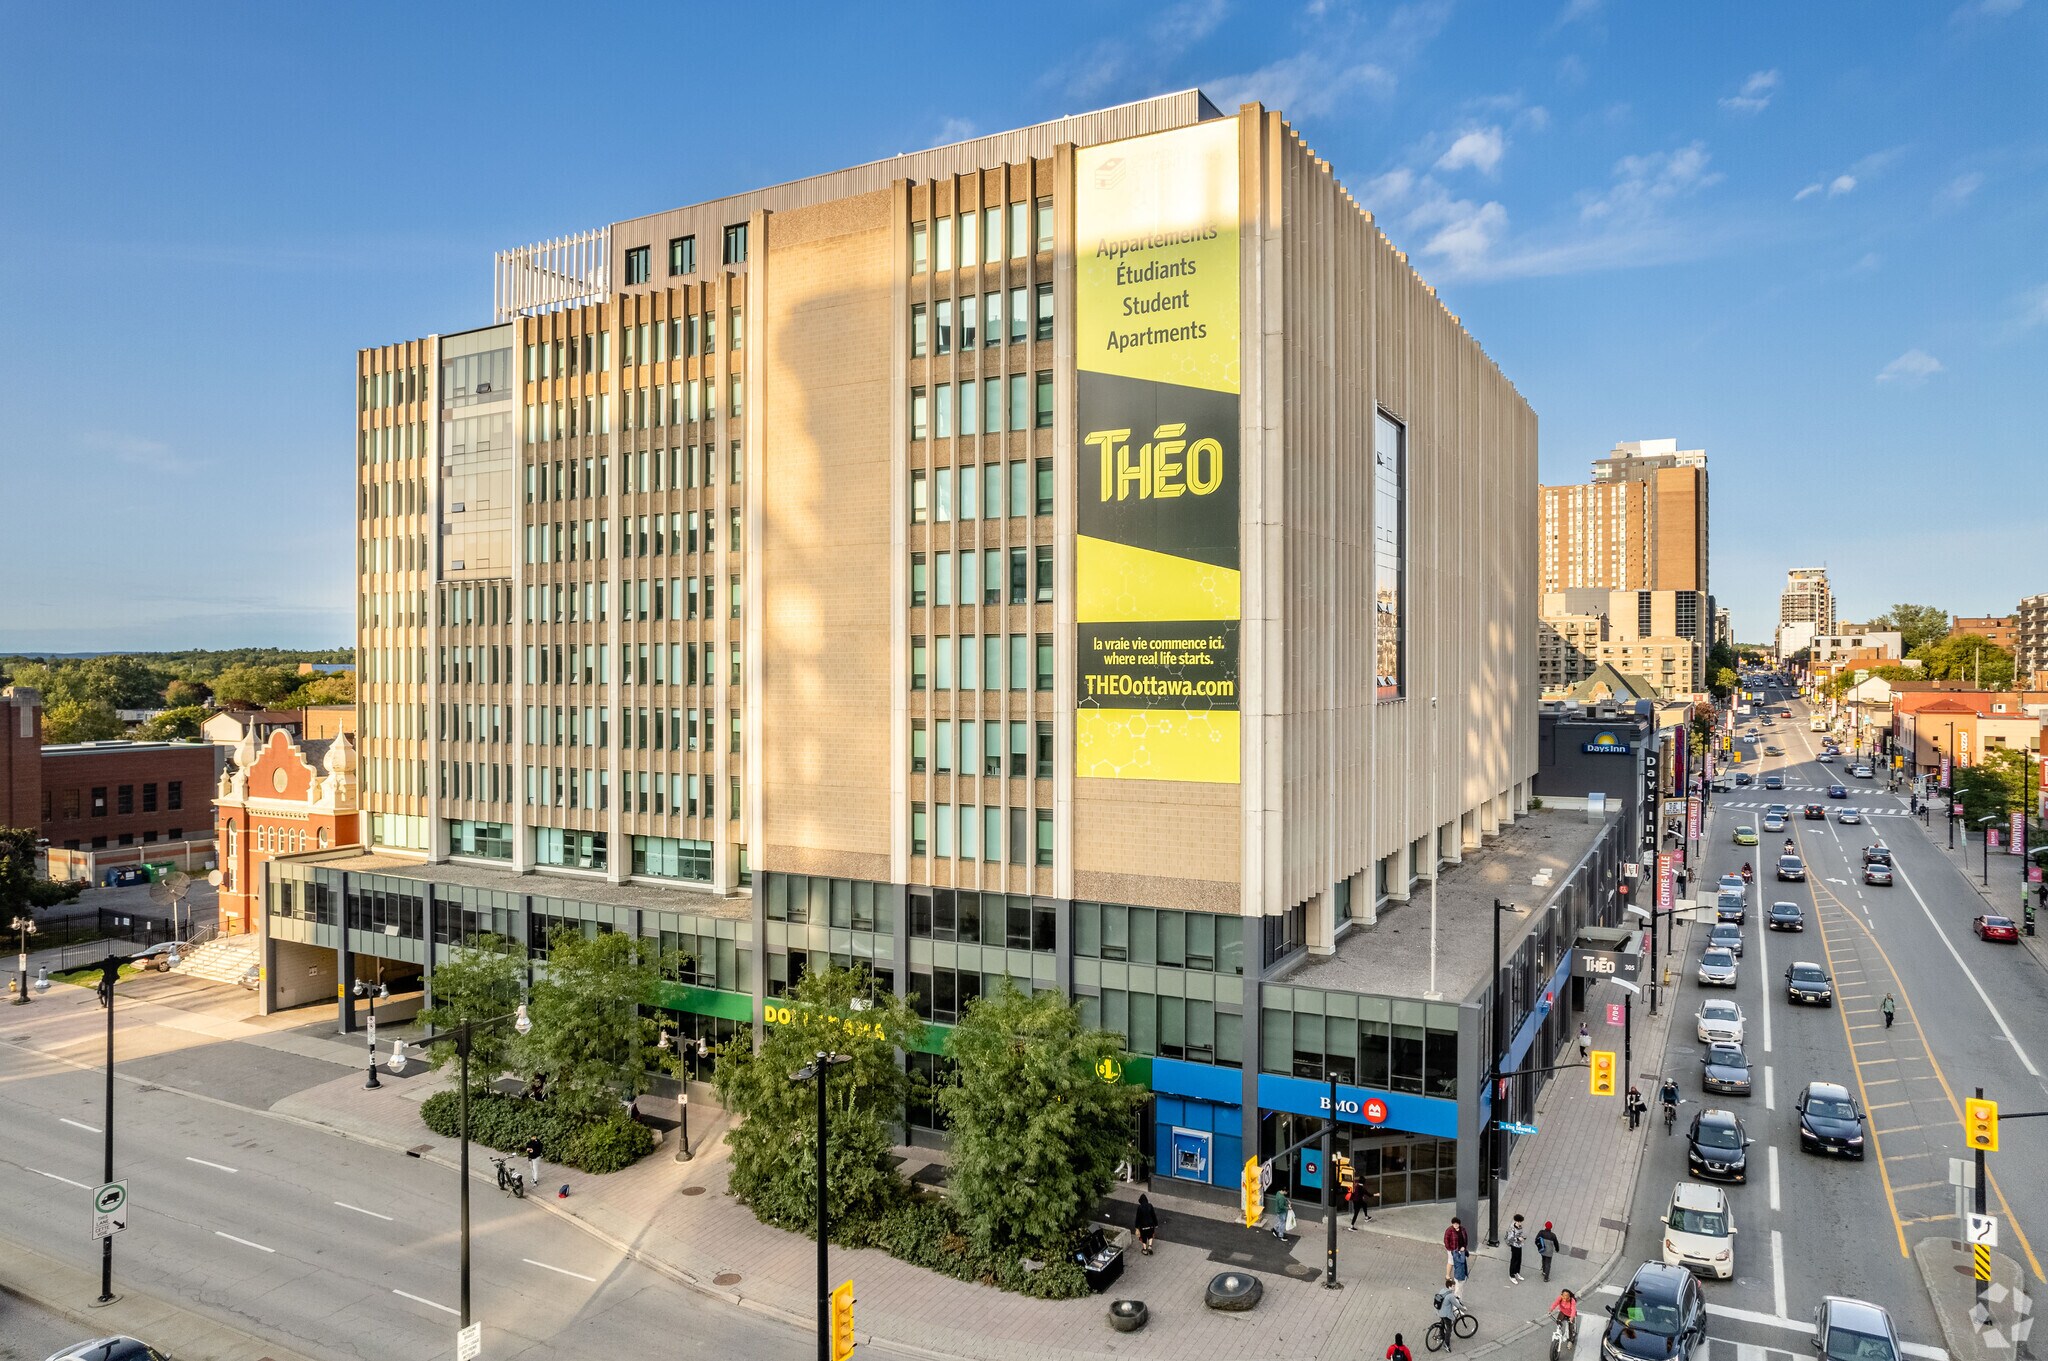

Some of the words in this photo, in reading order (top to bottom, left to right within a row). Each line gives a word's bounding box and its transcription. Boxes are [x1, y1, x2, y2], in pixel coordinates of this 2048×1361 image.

[1096, 221, 1218, 258] Appartements
[1116, 257, 1196, 286] Étudiants
[1122, 290, 1189, 317] Student
[1107, 321, 1207, 353] Apartments
[1093, 637, 1102, 651] la
[1104, 637, 1129, 650] vraie
[1132, 636, 1148, 650] vie
[1149, 638, 1207, 650] commence
[1208, 635, 1225, 650] ici.
[1104, 652, 1135, 665] where
[1137, 651, 1158, 665] real
[1159, 651, 1177, 665] life
[1179, 653, 1214, 665] starts.
[1085, 674, 1234, 696] THEOottawa.com
[1587, 744, 1609, 752] Days
[1646, 757, 1656, 802] Days
[1646, 811, 1654, 844] Inn
[1690, 803, 1698, 838] CENTRE-VILLE
[2012, 813, 2022, 852] DOWNTOWN
[1661, 856, 1670, 906] CENTRE-VILLE
[1320, 1096, 1359, 1114] BMO
[96, 1219, 109, 1227] LANE
